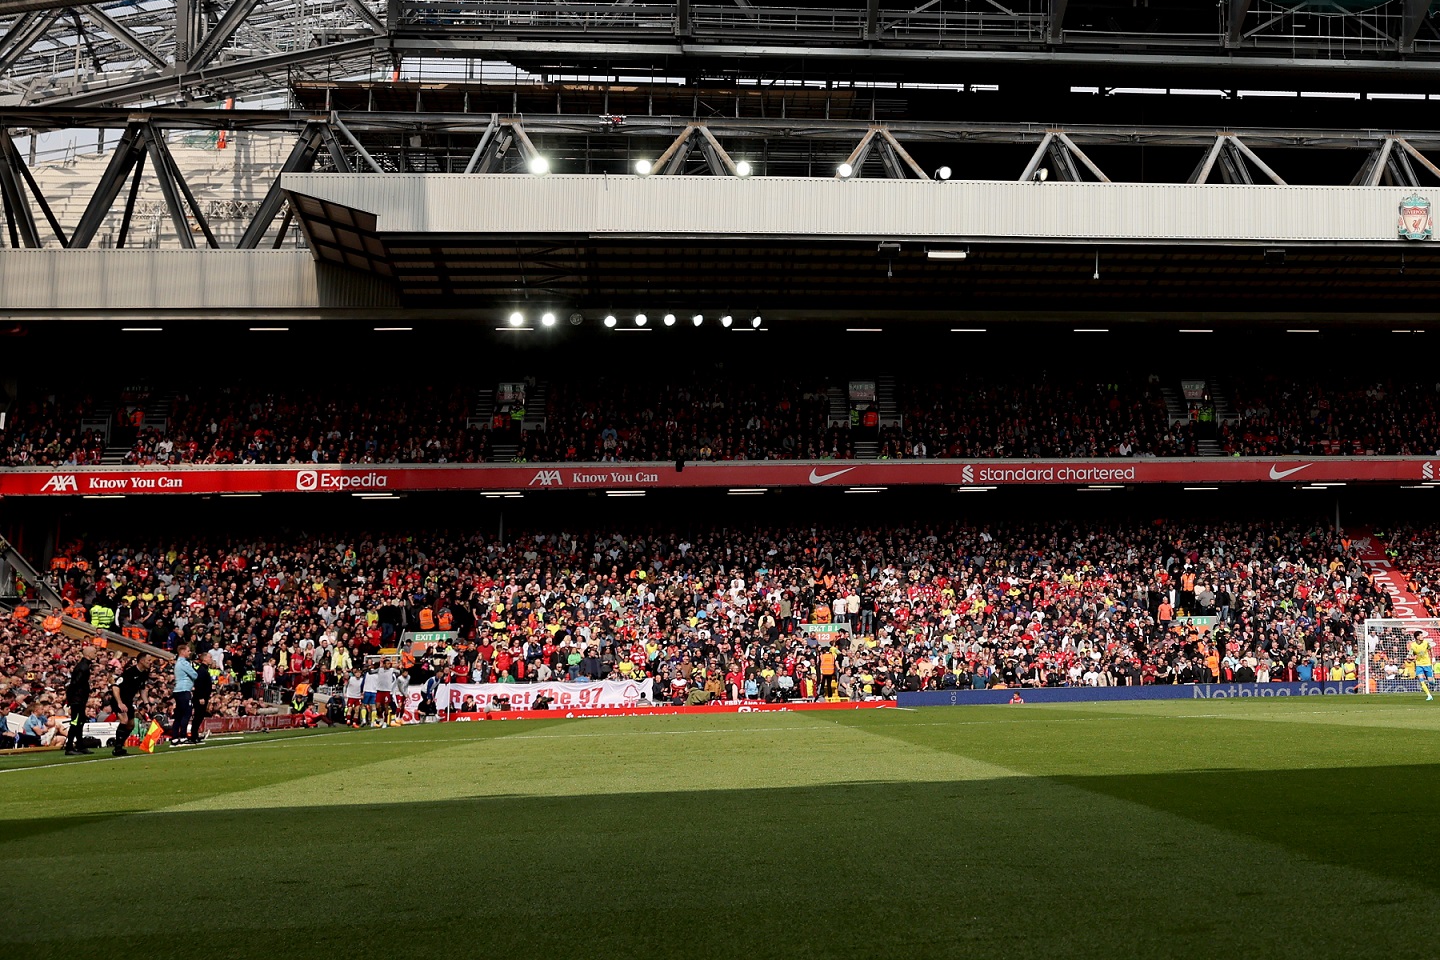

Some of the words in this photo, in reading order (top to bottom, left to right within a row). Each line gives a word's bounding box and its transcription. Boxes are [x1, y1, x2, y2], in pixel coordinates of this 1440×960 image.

[529, 470, 563, 485] AXA
[573, 473, 608, 483] Know
[610, 472, 633, 482] You
[635, 472, 659, 482] Can
[979, 467, 1054, 481] standard
[1057, 466, 1135, 480] chartered
[41, 475, 78, 491] AXA
[89, 477, 128, 488] Know
[130, 477, 155, 488] You
[158, 477, 183, 487] Can
[321, 473, 387, 490] Expedia
[580, 687, 603, 704] 97
[1193, 682, 1291, 699] Nothing
[1299, 682, 1355, 695] feels
